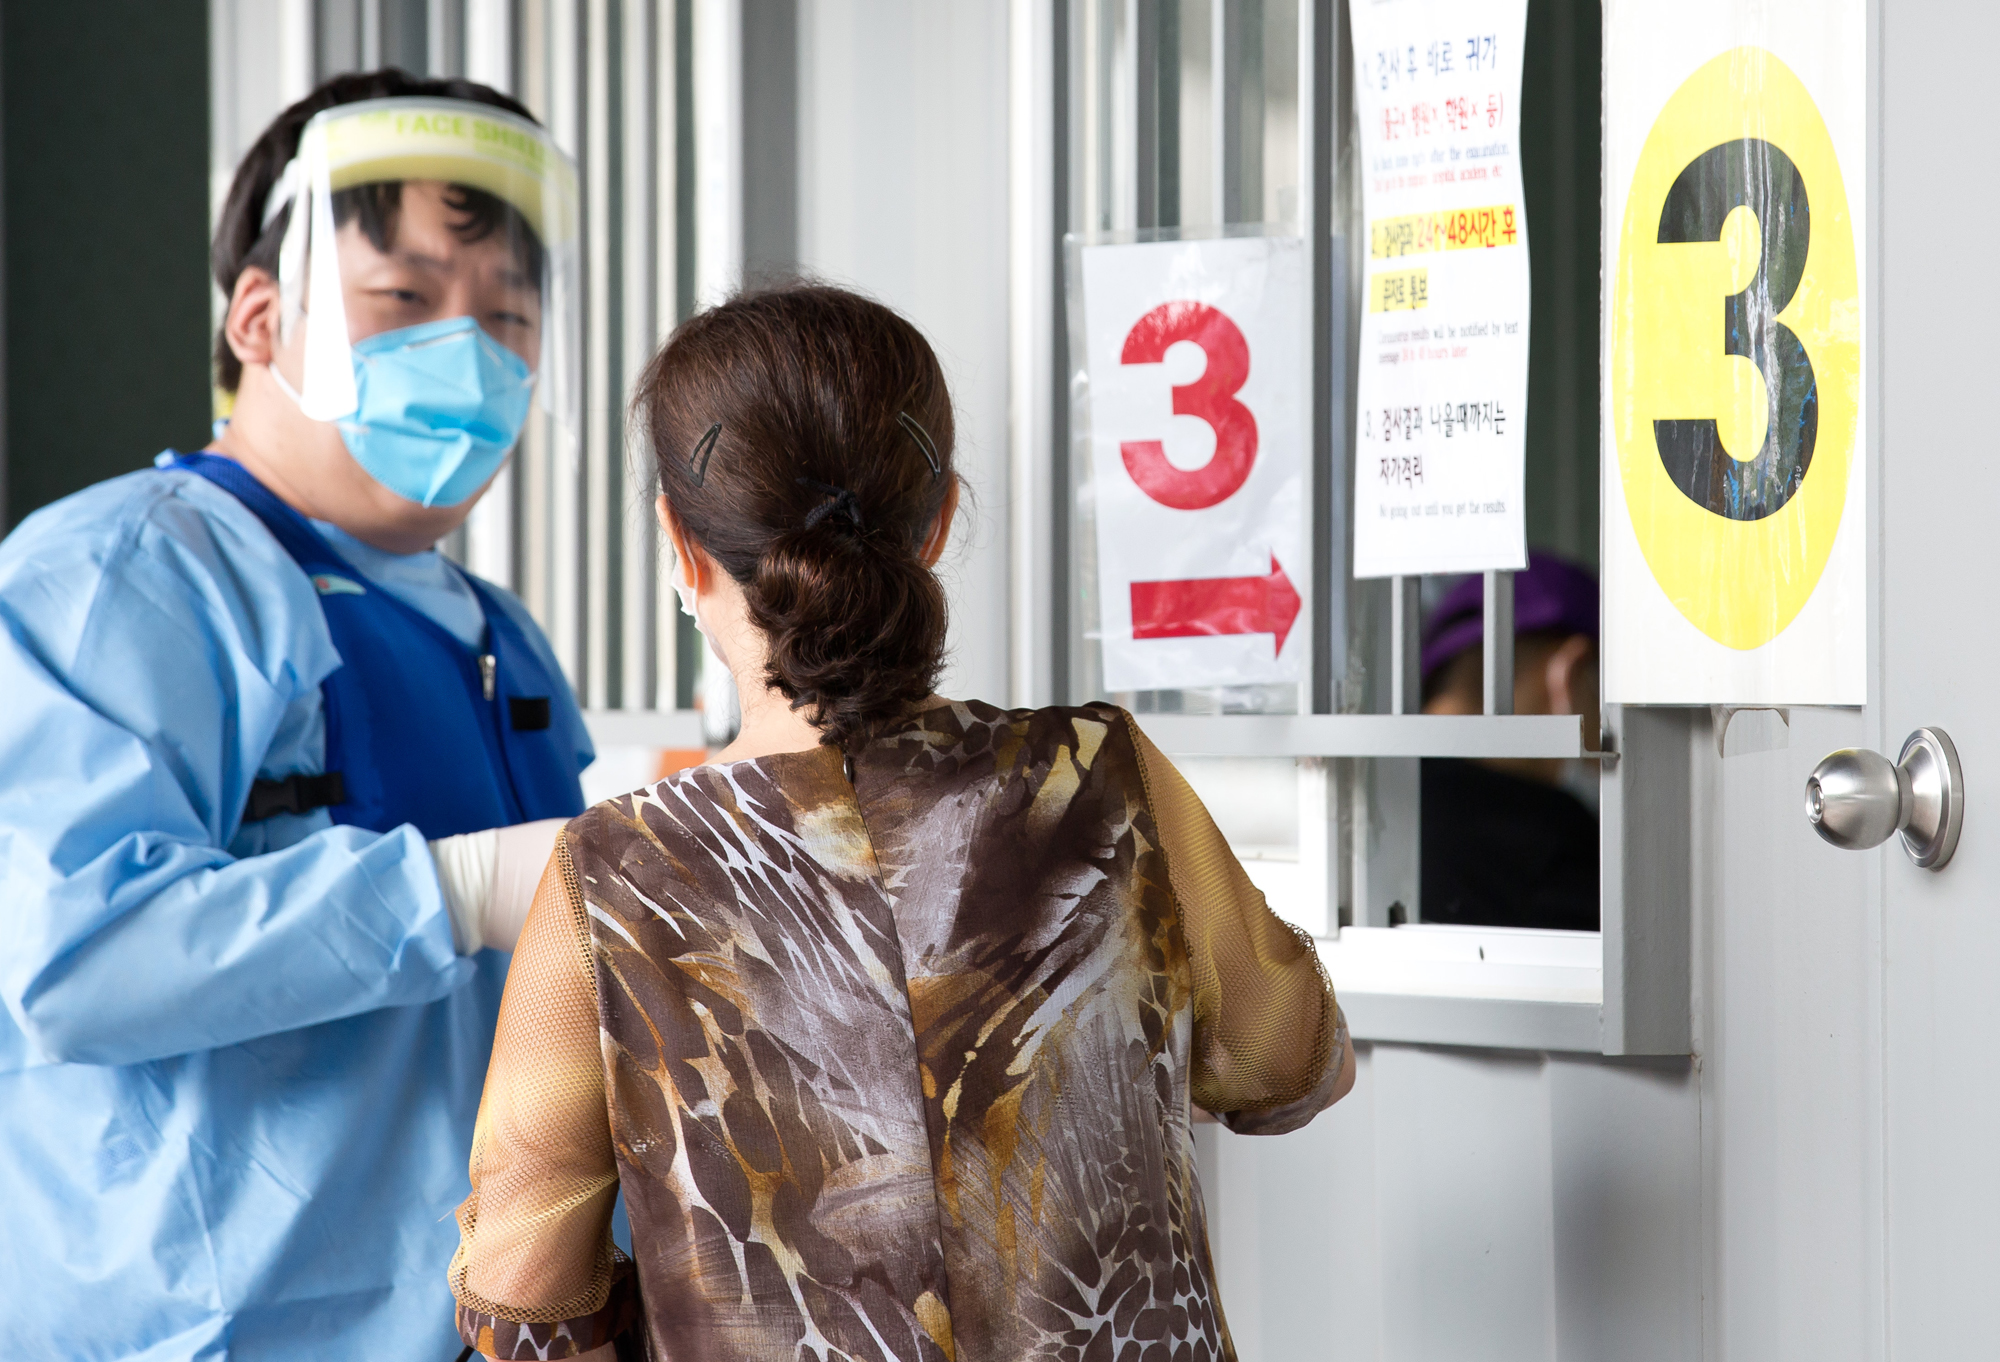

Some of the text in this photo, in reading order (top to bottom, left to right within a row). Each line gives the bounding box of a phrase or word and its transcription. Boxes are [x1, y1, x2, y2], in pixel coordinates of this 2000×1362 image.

[1377, 46, 1400, 91] 검사
[1407, 43, 1418, 81] 후
[1427, 40, 1455, 76] 바로
[1466, 33, 1497, 71] 귀가
[1486, 91, 1504, 128] 등)
[396, 113, 466, 139] FACE
[472, 118, 550, 160] SHIEL
[1417, 209, 1497, 248] 24~48시간
[1502, 206, 1517, 243] 후
[1383, 275, 1428, 312] 문자로 통보
[1459, 320, 1488, 338] notified
[1492, 319, 1501, 340] by
[1504, 319, 1518, 335] text
[1653, 138, 1818, 521] 3
[1121, 300, 1259, 511] 3
[1382, 405, 1423, 442] 검사결과
[1430, 400, 1507, 438] 나올때까지는
[1379, 454, 1424, 490] 자가격리
[1456, 501, 1465, 517] get
[1469, 499, 1479, 515] the
